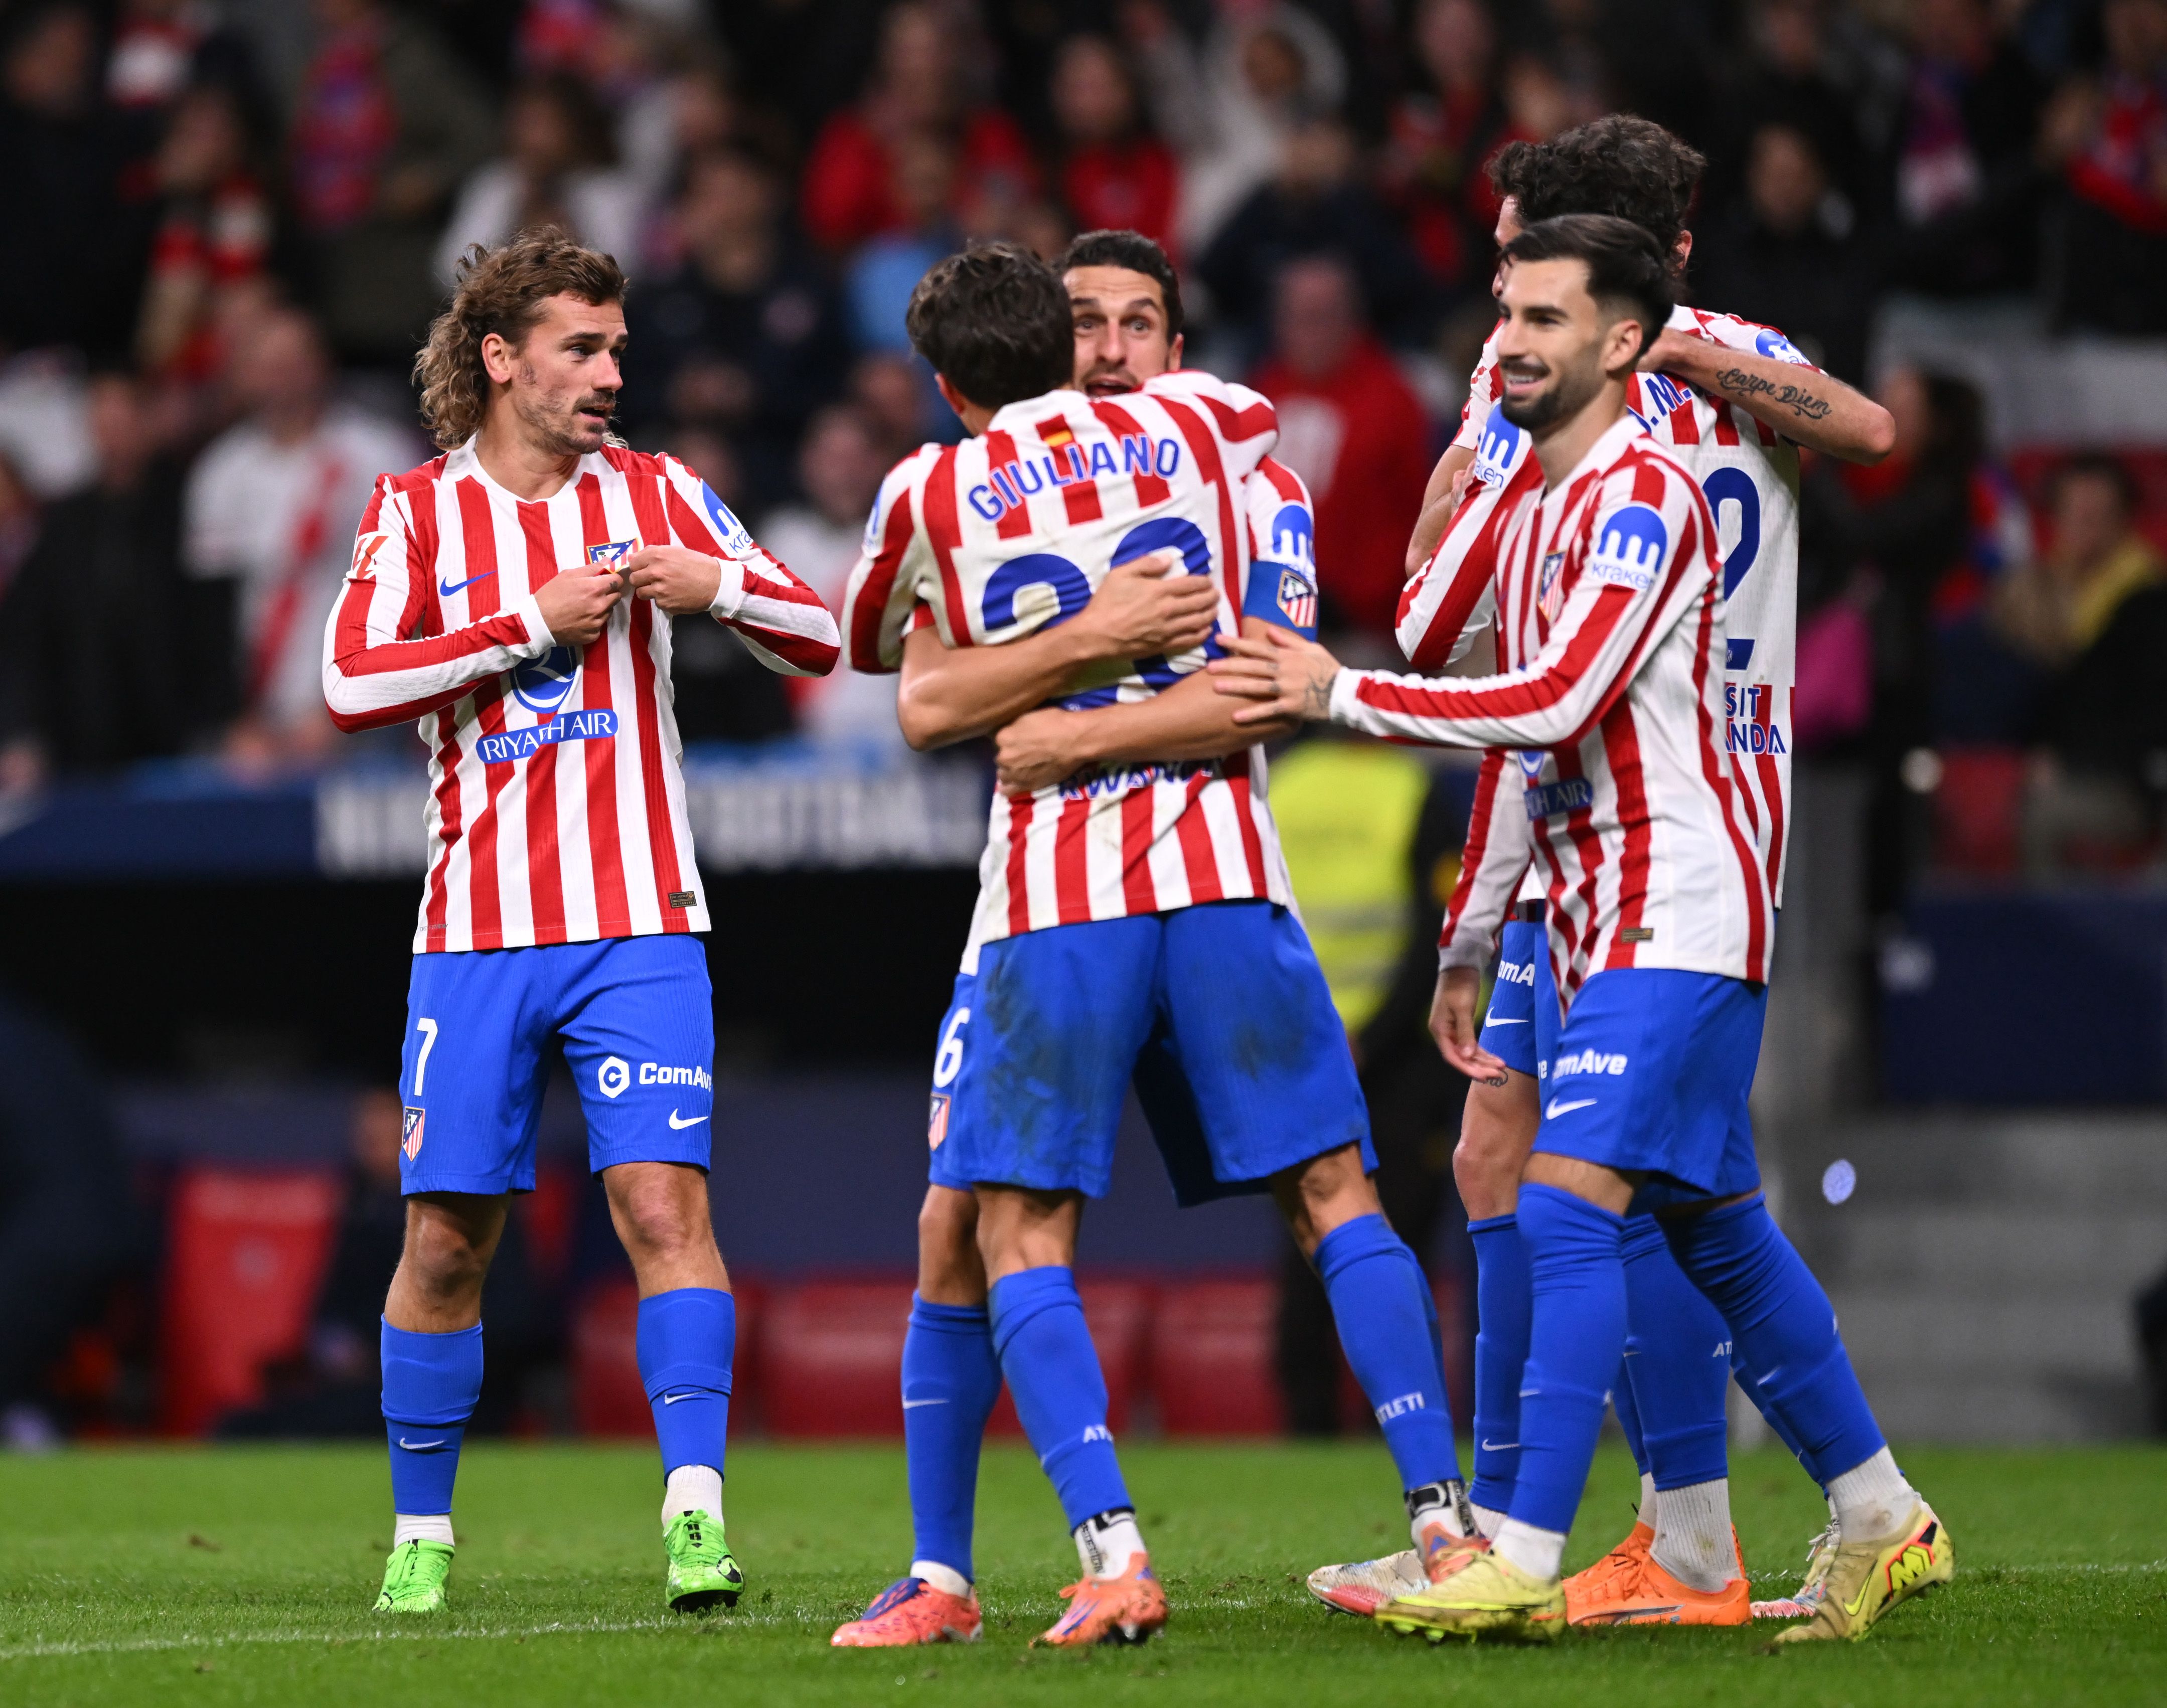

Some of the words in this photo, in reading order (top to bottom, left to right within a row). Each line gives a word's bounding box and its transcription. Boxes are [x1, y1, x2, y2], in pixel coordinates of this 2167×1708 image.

[1716, 368, 1777, 397] Carpe
[1775, 385, 1832, 420] Diem
[968, 434, 1180, 523] GIULIANO
[1475, 458, 1504, 489] aken
[729, 530, 752, 553] kra
[1592, 562, 1655, 589] krake
[1725, 686, 1761, 718] SIT
[569, 712, 612, 736] AIR
[1725, 722, 1788, 754] NDA
[1556, 780, 1589, 807] AIR
[1497, 960, 1535, 987] omA
[413, 1017, 438, 1097] 7
[933, 1007, 971, 1089] 6
[1553, 1047, 1628, 1079] omAve
